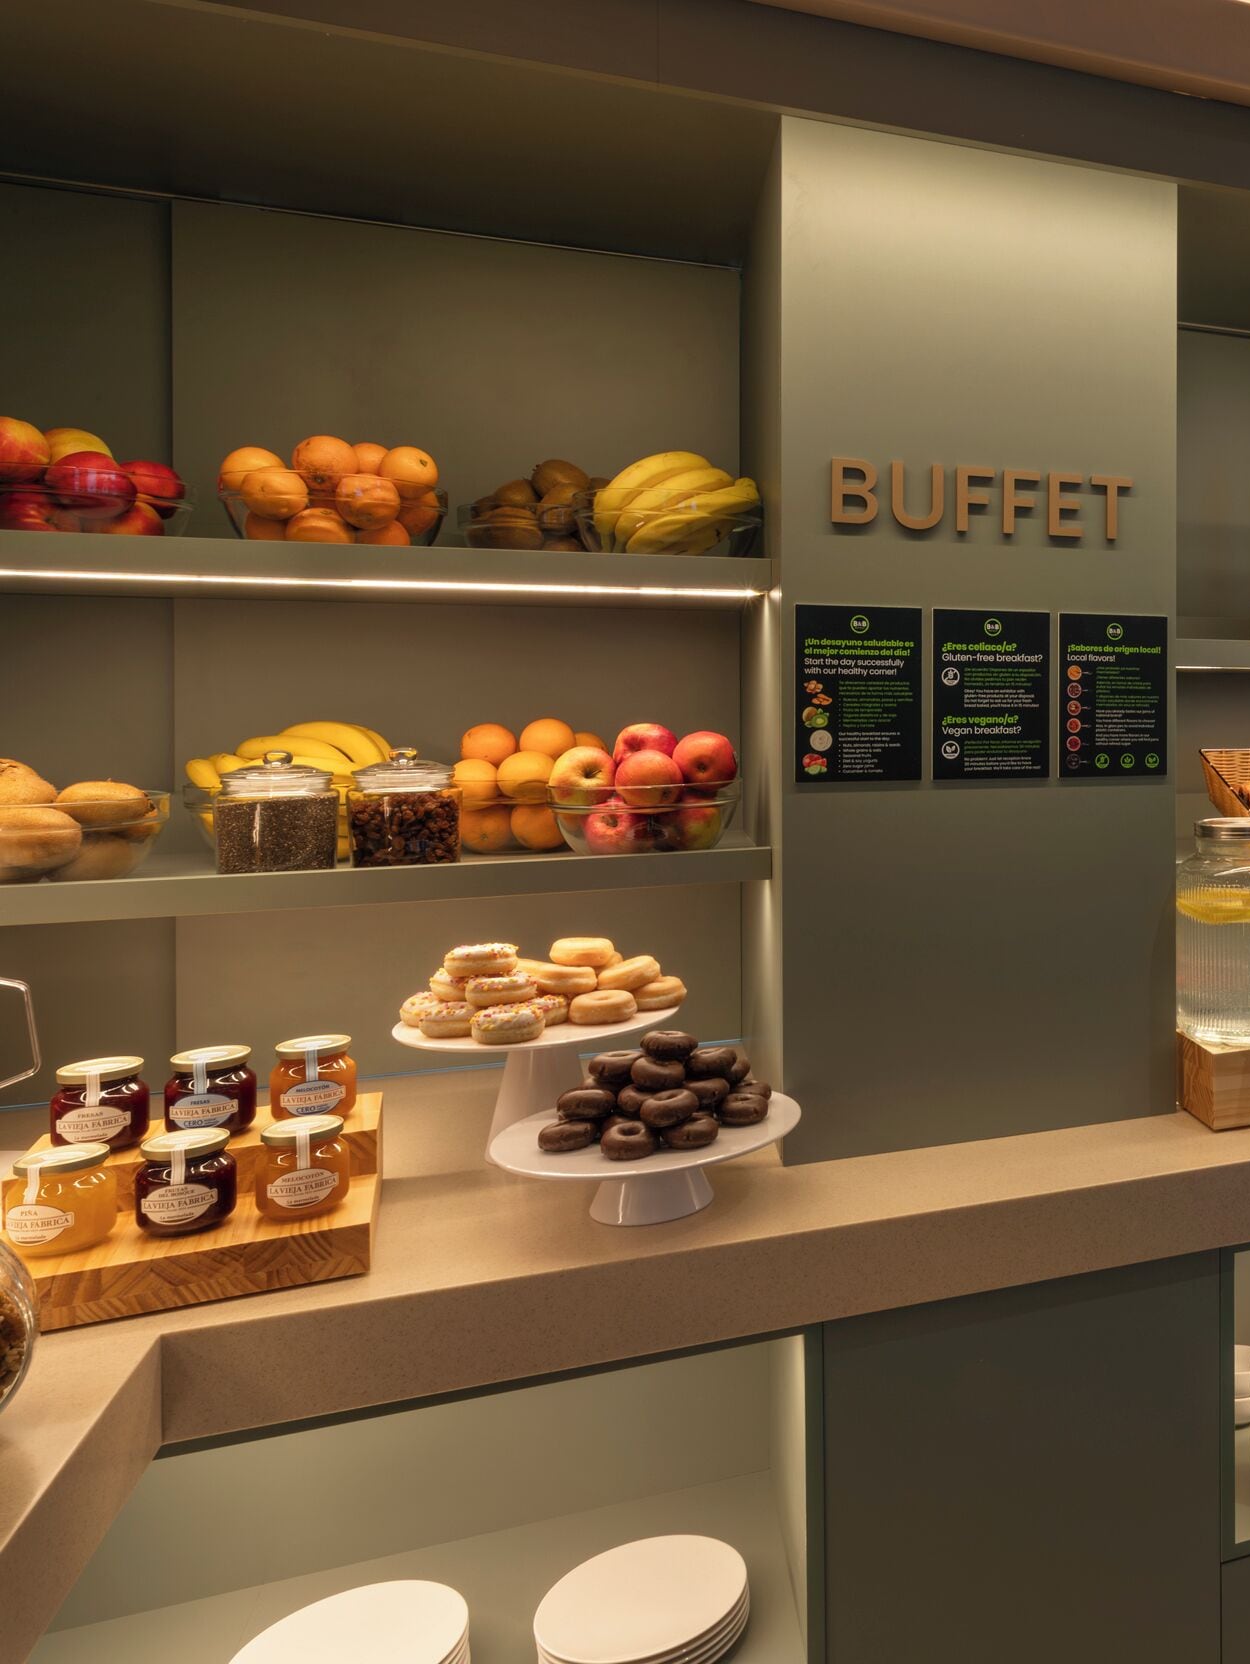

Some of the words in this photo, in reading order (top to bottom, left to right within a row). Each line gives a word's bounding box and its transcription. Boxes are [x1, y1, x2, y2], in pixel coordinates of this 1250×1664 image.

[831, 456, 1134, 540] BUFFET
[805, 638, 819, 647] ¡Un
[821, 639, 862, 648] desayuno
[942, 642, 966, 652] ¿Eres
[813, 648, 838, 656] mejor
[1068, 644, 1102, 652] ¡Sabores
[1115, 645, 1139, 655] origen
[942, 653, 994, 661] Gluten-free
[996, 653, 1043, 662] breakfast?
[840, 658, 856, 667] day
[857, 658, 904, 668] successfully
[838, 668, 868, 677] healthy
[942, 716, 967, 725] ¿Eres
[968, 713, 1019, 725] vegano/a?
[942, 726, 972, 736] Vegan
[974, 726, 1021, 734] breakfast?
[30, 1217, 70, 1228] FÁBRICA
